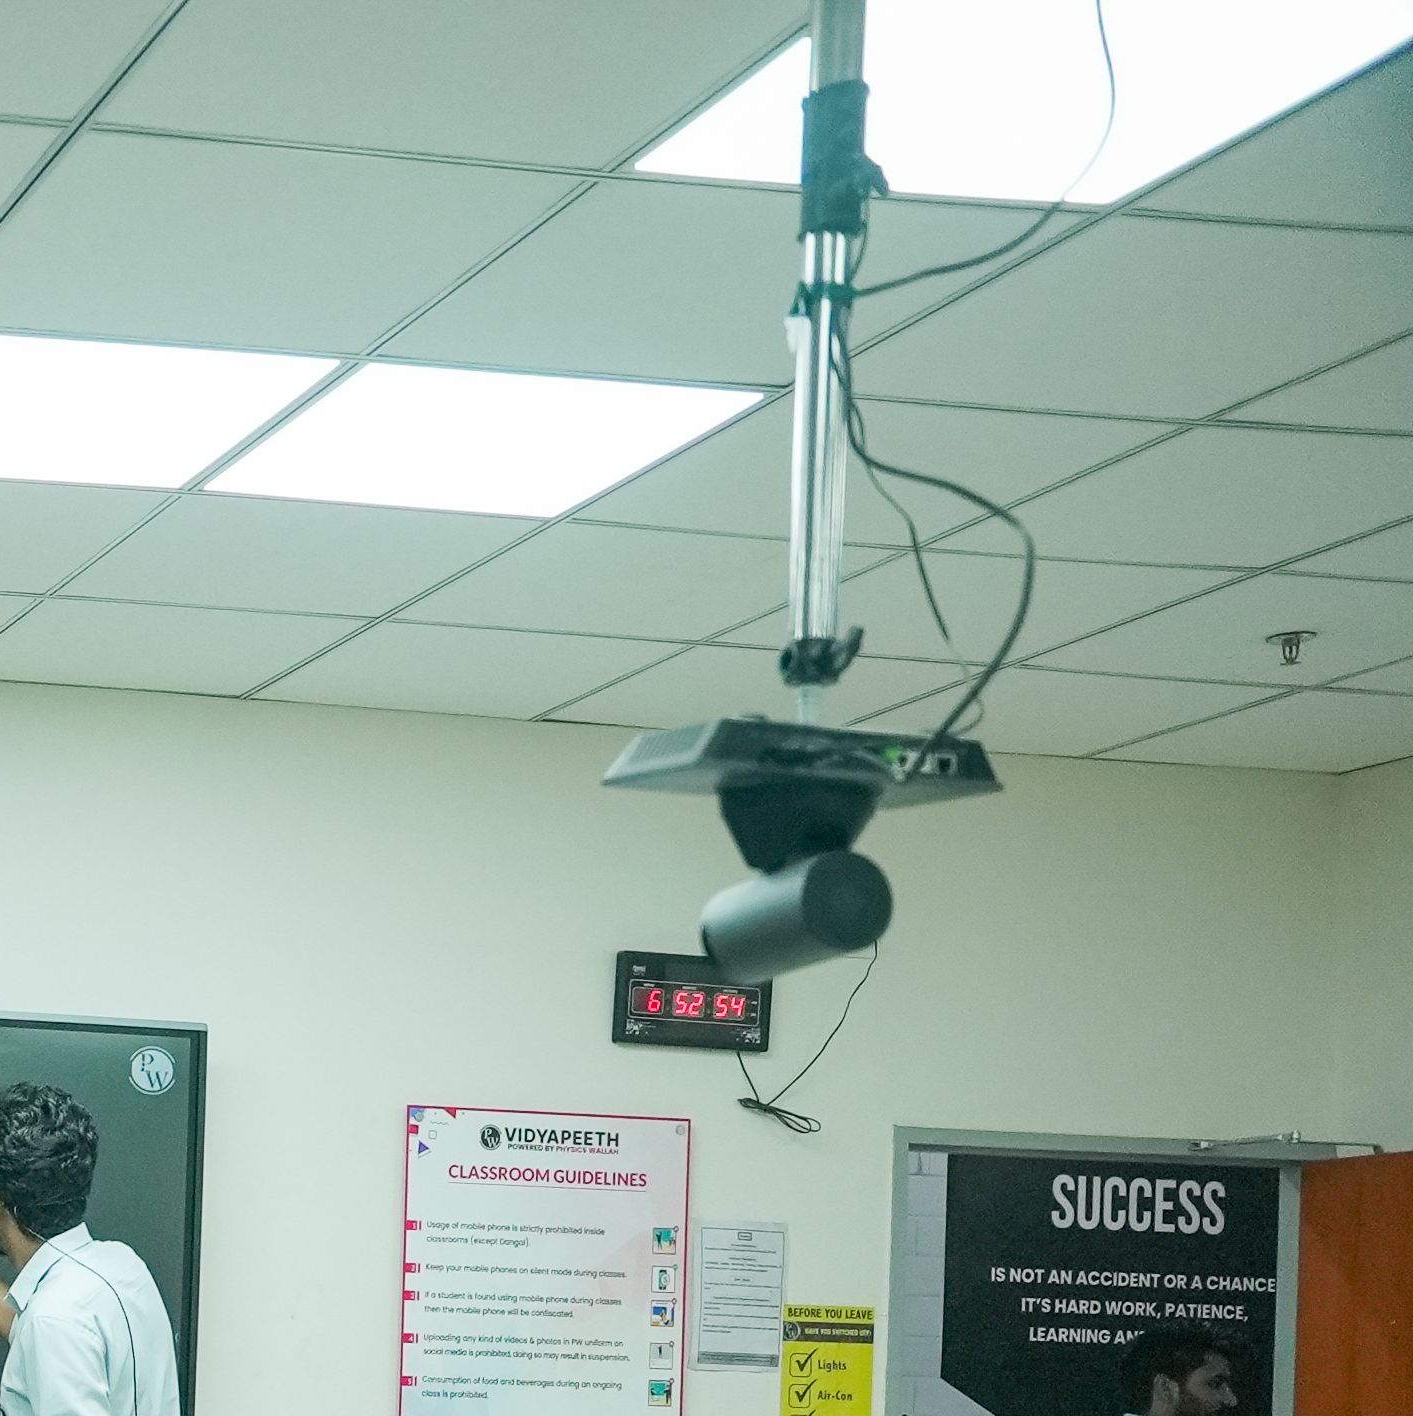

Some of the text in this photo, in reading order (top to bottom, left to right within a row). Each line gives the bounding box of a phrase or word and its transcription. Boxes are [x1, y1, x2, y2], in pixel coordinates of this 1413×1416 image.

[647, 989, 746, 1018] 6 52 54
[504, 1127, 619, 1148] VIDYAPEETH
[507, 1143, 619, 1155] POWERED BY PHYSICS WALLAH
[448, 1164, 647, 1187] CLASSROOM GUIDELINES
[1051, 1174, 1226, 1235] SUCCESS
[991, 1267, 1277, 1293] IS NOT AN ACCIDENT OR A CHANCE
[787, 1307, 873, 1320] BEFORE YOU LEAVE
[1054, 1298, 1102, 1315] HARD
[1105, 1300, 1161, 1320] WORK,
[1164, 1302, 1249, 1322] PATIENCE,
[1029, 1326, 1111, 1344] LEARNING
[818, 1359, 847, 1372] Lights
[817, 1391, 853, 1401] Air-Con
